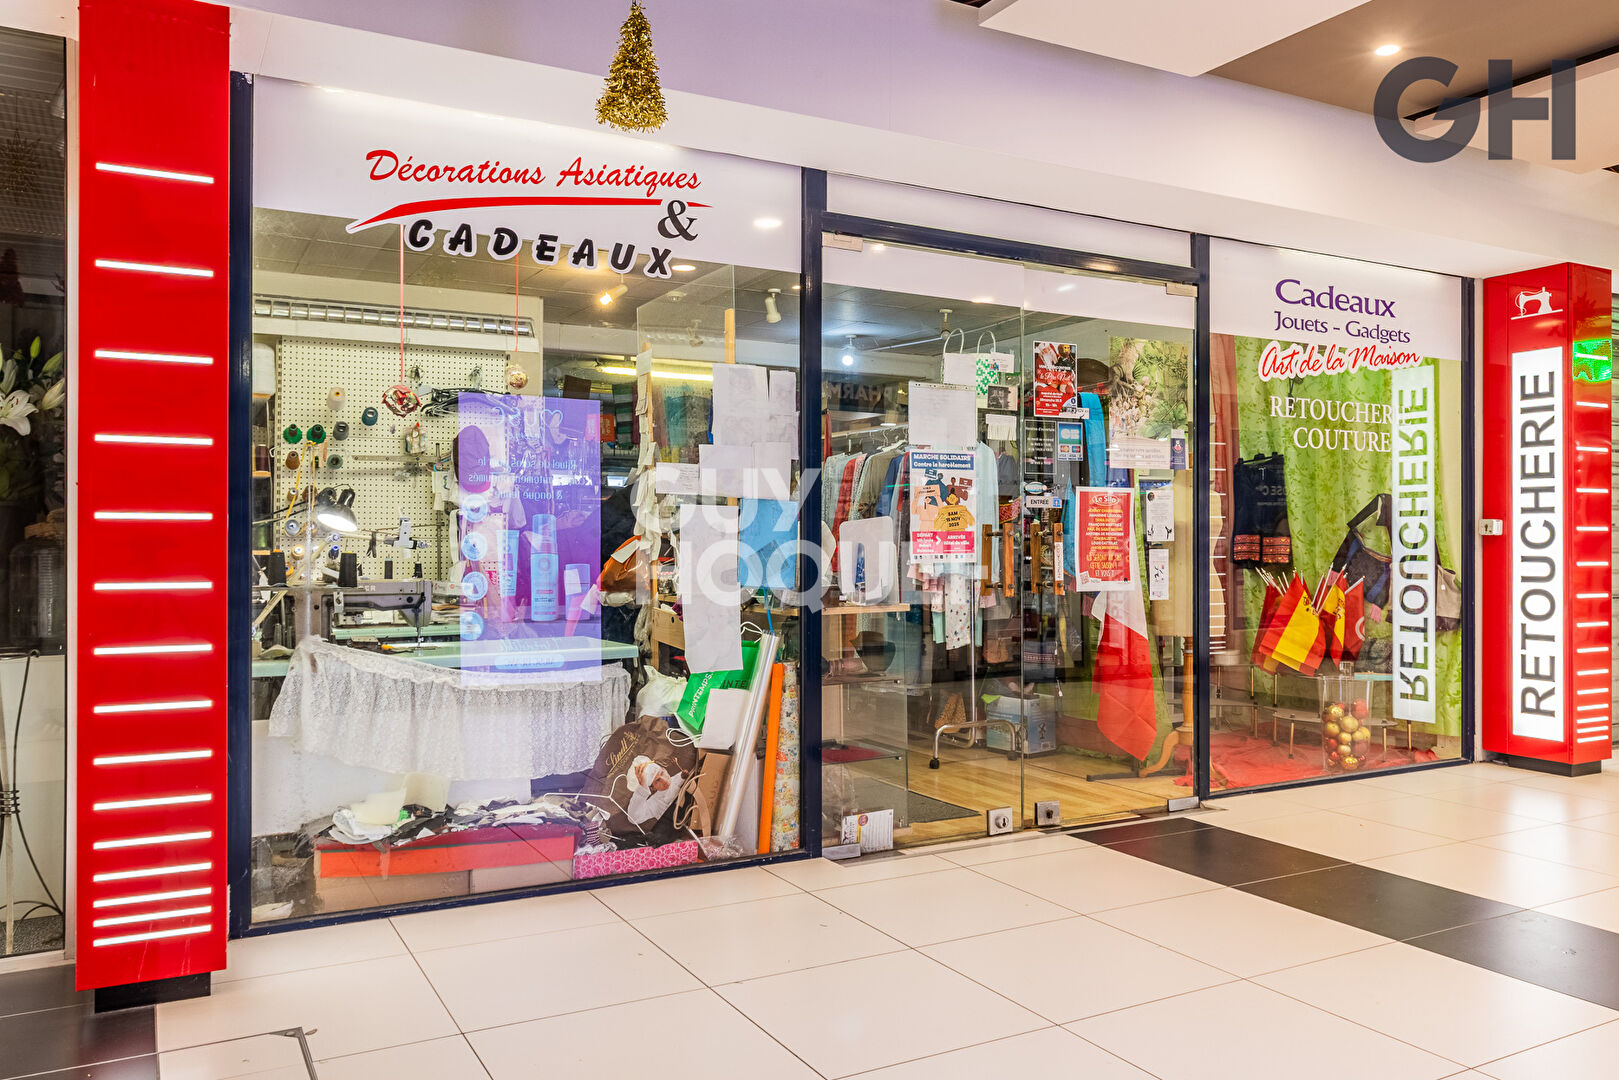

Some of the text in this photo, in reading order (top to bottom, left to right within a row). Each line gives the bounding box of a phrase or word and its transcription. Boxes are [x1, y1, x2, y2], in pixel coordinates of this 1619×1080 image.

[366, 150, 701, 197] Décorations Asiatiques
[657, 200, 698, 241] &
[408, 219, 672, 276] CADEAUX
[1275, 279, 1396, 318] Cadeaux
[1274, 311, 1328, 333] Jouets
[1345, 320, 1411, 343] Gadgets
[1262, 344, 1420, 377] Art de la Maison
[1270, 396, 1411, 425] RETOUCHERE
[1293, 427, 1392, 453] COUTURE
[913, 453, 939, 461] MARCHE
[1094, 495, 1103, 503] Le
[1519, 371, 1556, 718] RETOUCHERIE
